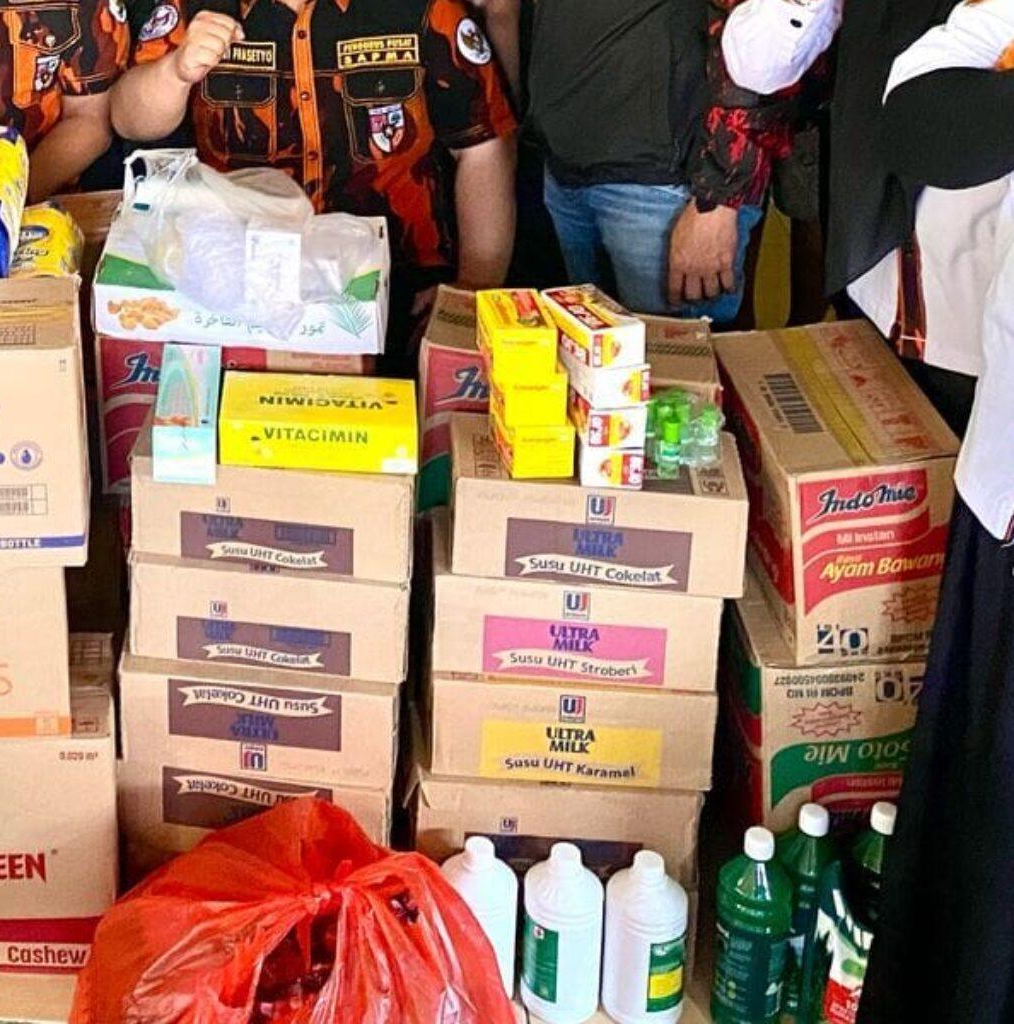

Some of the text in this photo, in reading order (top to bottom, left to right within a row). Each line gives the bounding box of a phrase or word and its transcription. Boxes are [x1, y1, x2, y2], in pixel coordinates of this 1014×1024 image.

[259, 395, 383, 411] VITACIMIN
[263, 426, 369, 444] VITACIMIN
[249, 548, 274, 560] UHT
[529, 557, 662, 583] Susu UHT Cokelat
[819, 558, 874, 585] Ayam
[549, 624, 600, 642] ULTRA
[551, 638, 594, 653] MILK
[509, 652, 638, 677] Susu UHT Stroberi
[191, 688, 320, 715] Susu UHT Cokelat
[546, 726, 595, 742] ULTRA
[548, 740, 592, 755] MILK
[804, 743, 852, 765] Mie
[505, 757, 637, 778] Susu UHT Karamel
[187, 777, 238, 795] Cokelat
[241, 786, 271, 804] UHT
[7, 944, 88, 966] Cashew
